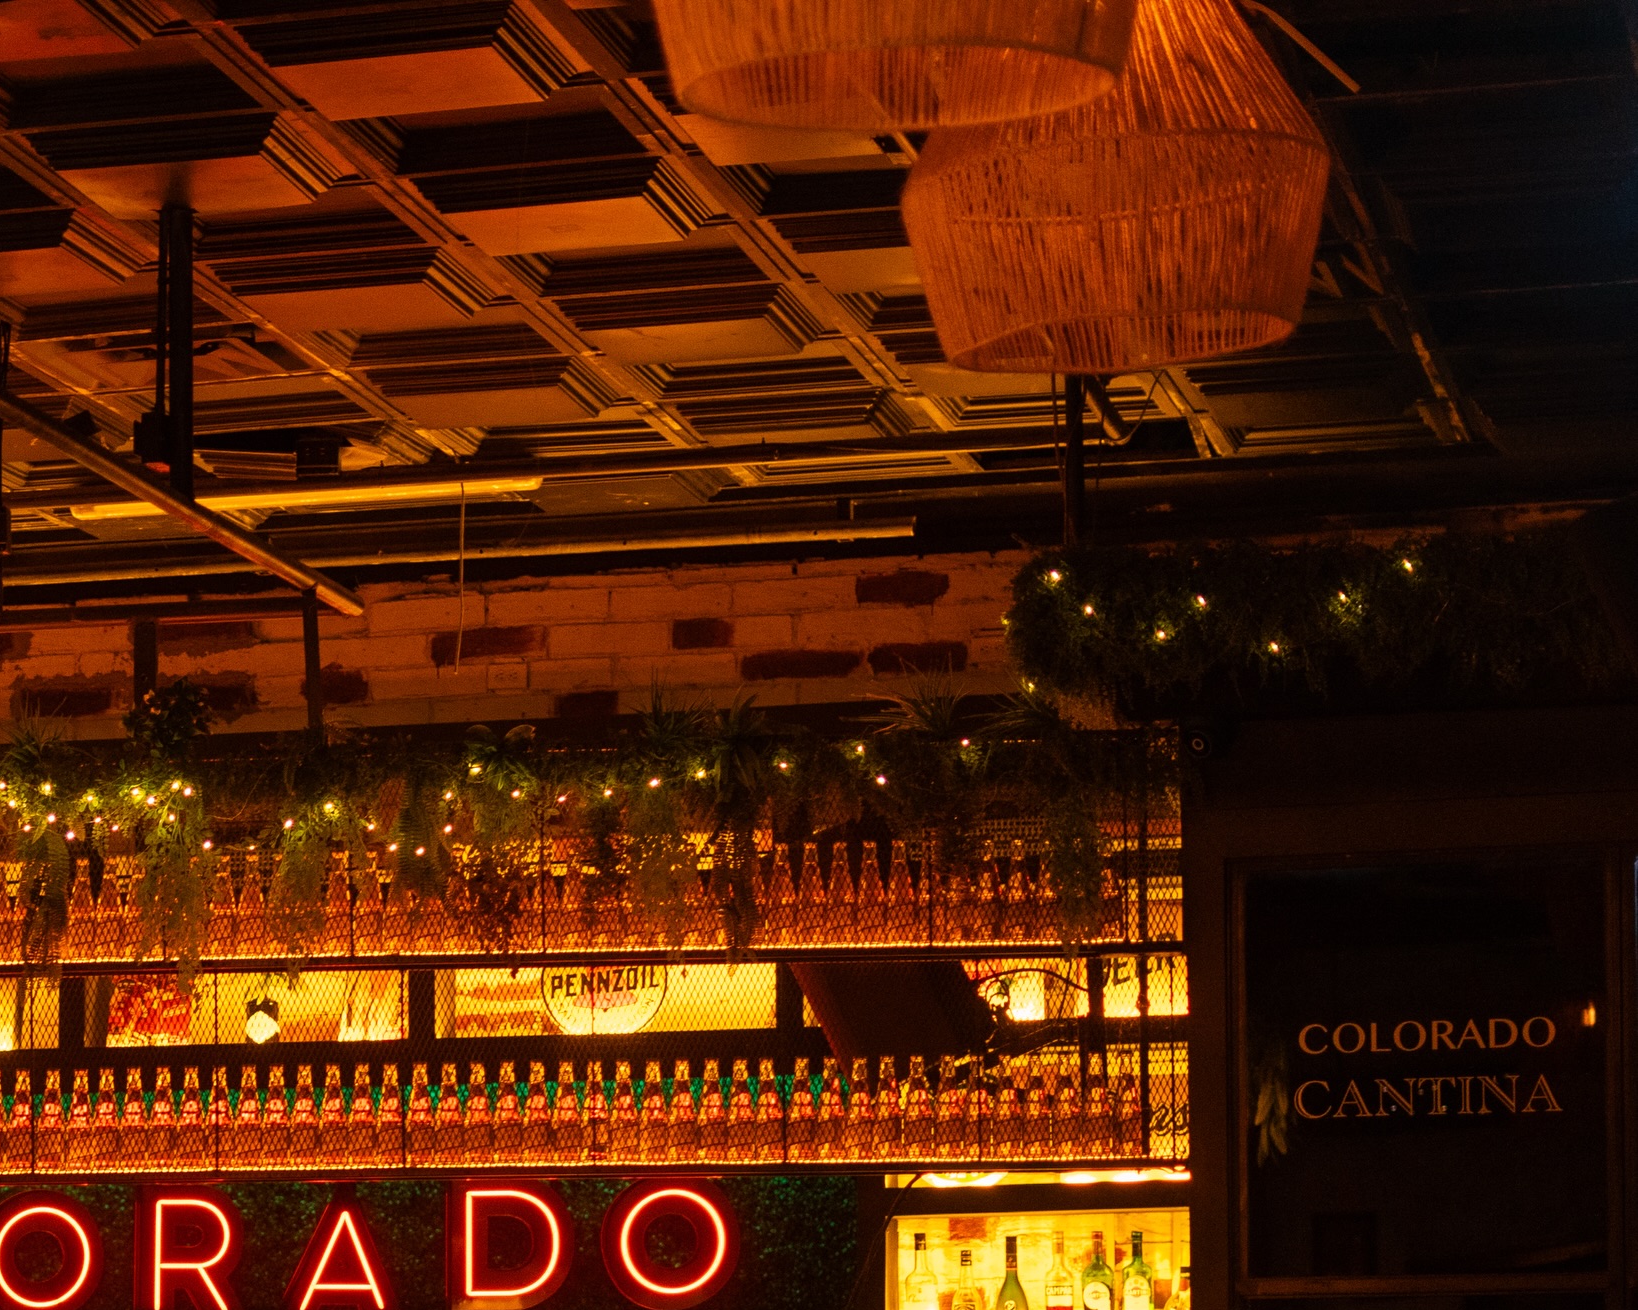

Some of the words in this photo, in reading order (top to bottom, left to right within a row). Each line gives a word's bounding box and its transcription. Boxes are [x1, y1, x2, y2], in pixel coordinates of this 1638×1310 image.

[551, 964, 659, 999] PENNZOIL
[1298, 1016, 1557, 1055] COLORADO
[1294, 1073, 1563, 1119] CANTINA
